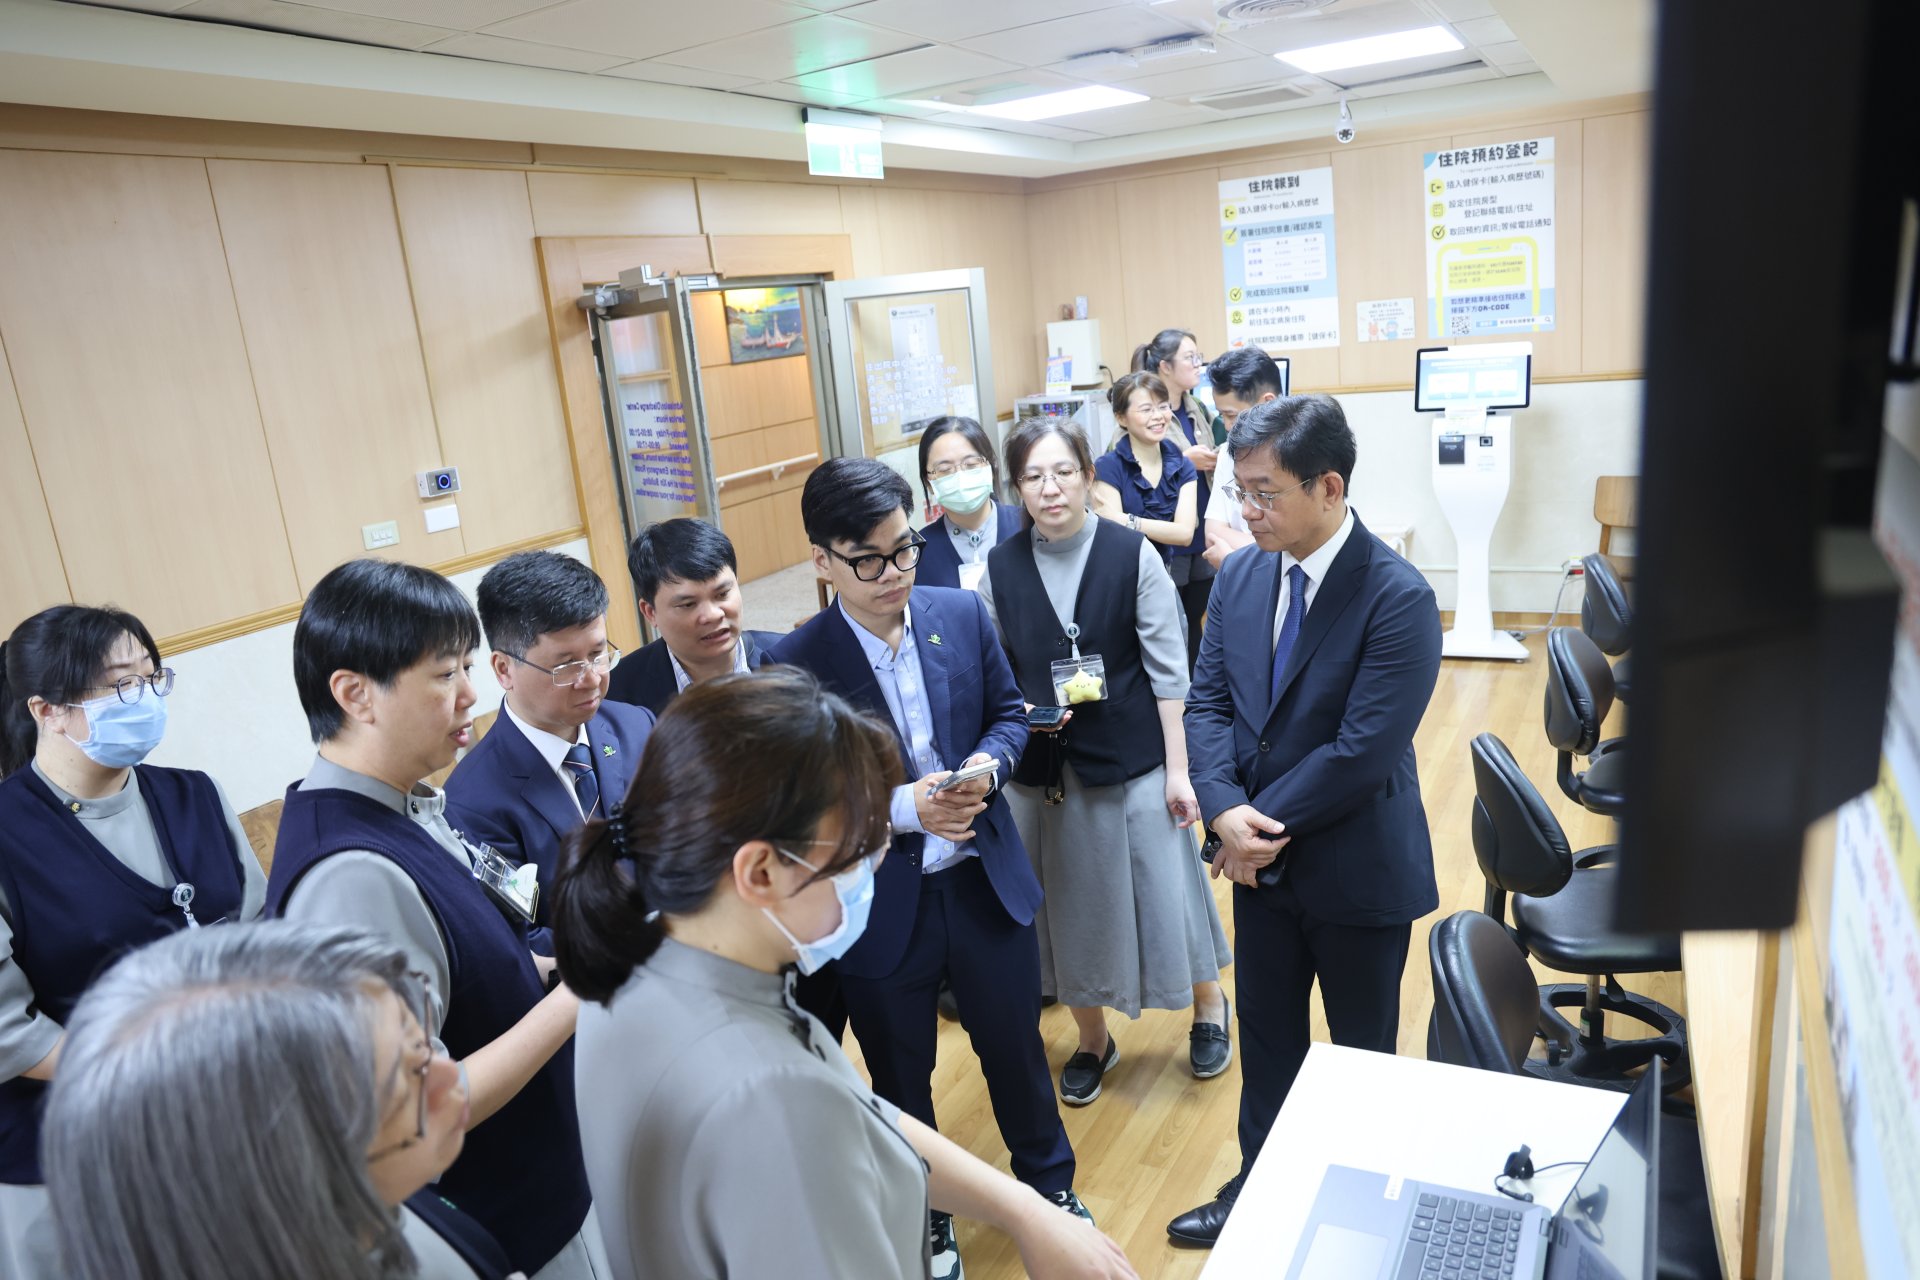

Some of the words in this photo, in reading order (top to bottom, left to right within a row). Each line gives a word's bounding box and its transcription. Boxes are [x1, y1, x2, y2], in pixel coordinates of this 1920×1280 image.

[1439, 141, 1538, 167] 住院預約登記
[1248, 175, 1300, 193] 住院報到
[1449, 195, 1497, 208] 設定住院房型
[1465, 204, 1533, 218] 登記聯絡電話/住址
